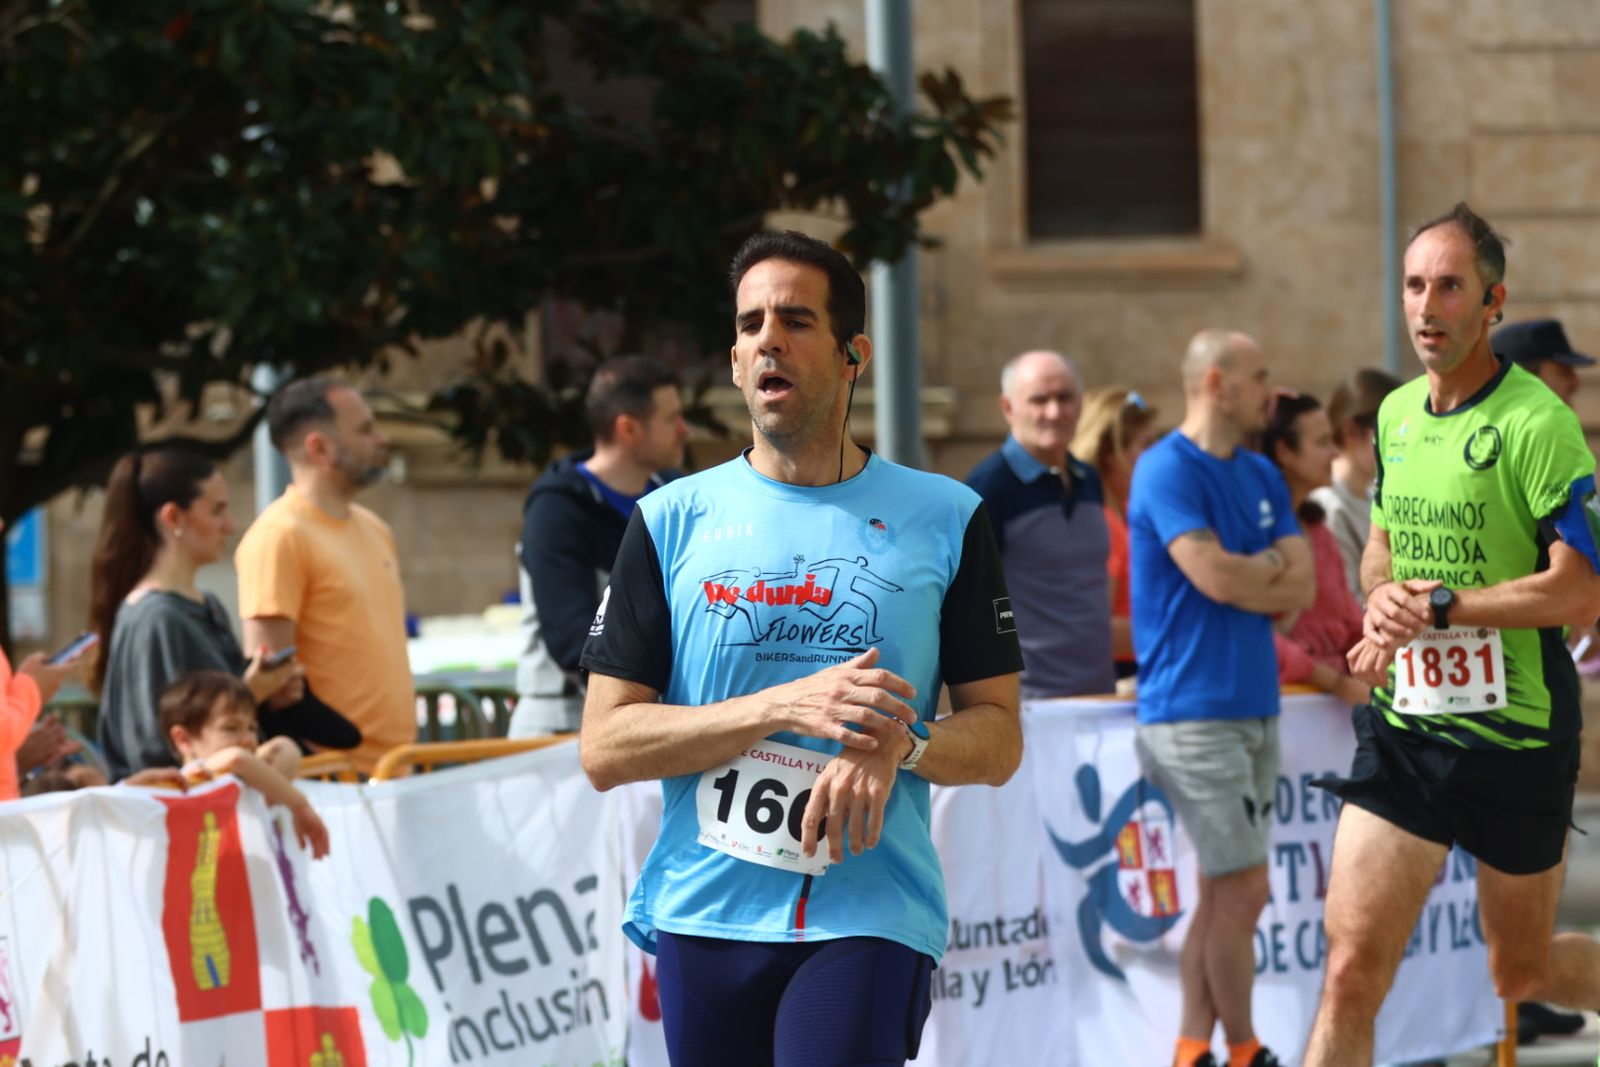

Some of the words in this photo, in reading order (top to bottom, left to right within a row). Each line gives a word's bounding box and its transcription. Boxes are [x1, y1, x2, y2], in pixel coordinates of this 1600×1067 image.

[1392, 530, 1487, 564] ARBAJOSA
[765, 616, 864, 646] FLOWERS
[1401, 642, 1495, 688] 1831
[750, 749, 803, 770] CASTILLA
[805, 761, 815, 775] Y
[971, 966, 991, 1010] y
[442, 966, 611, 1066] inclusin
